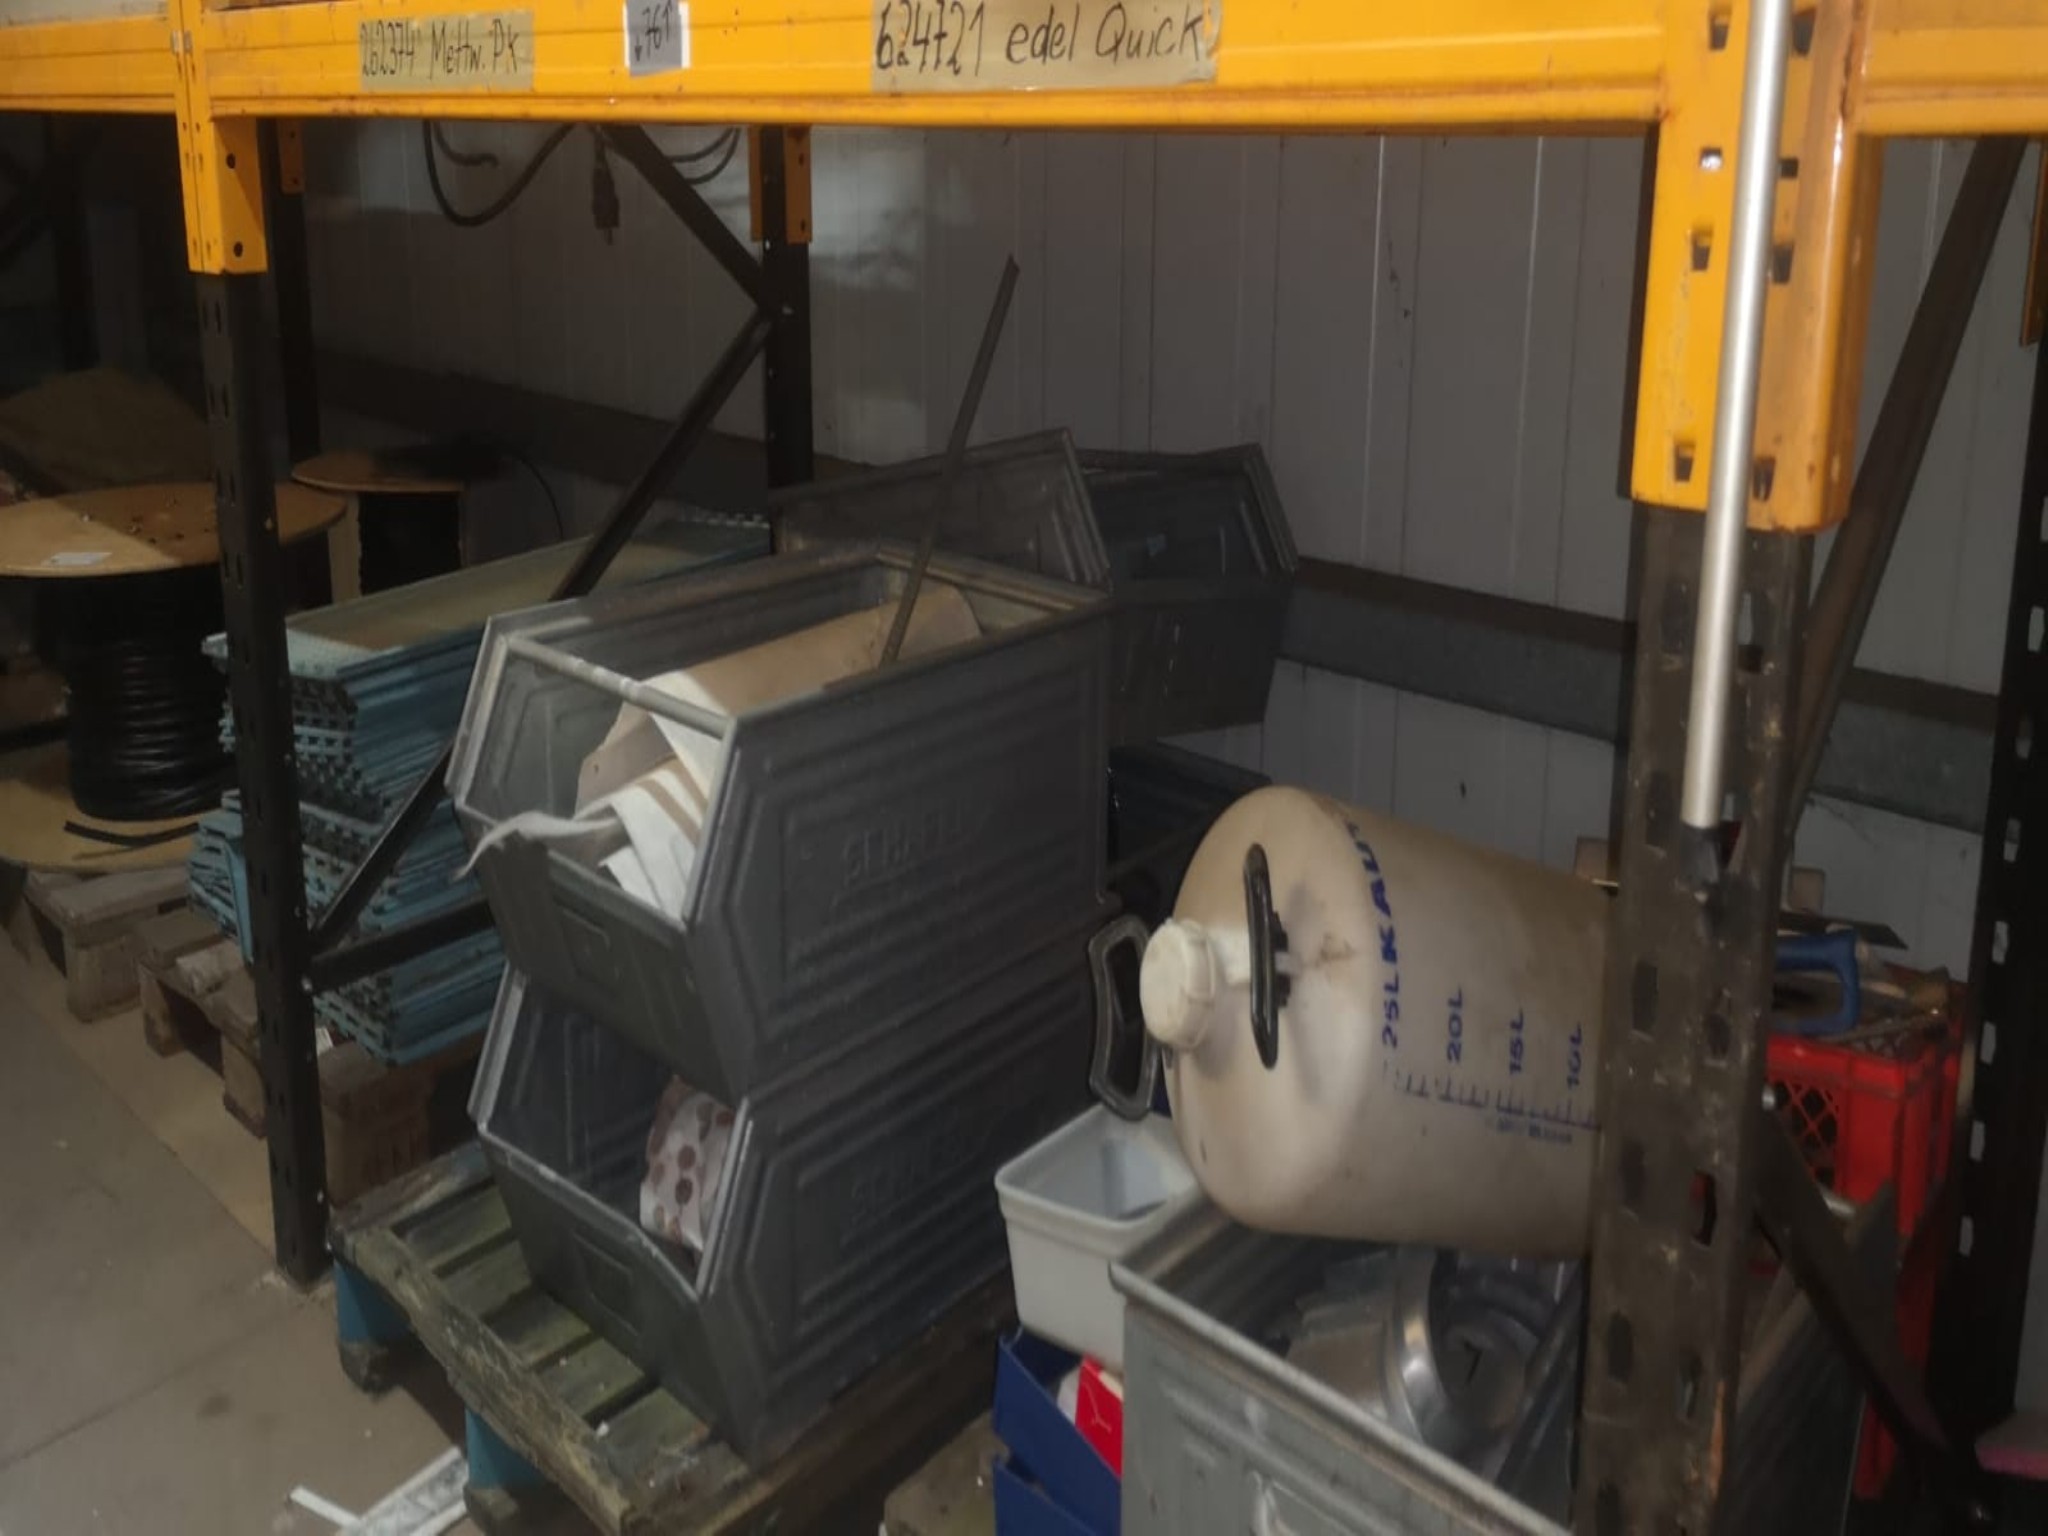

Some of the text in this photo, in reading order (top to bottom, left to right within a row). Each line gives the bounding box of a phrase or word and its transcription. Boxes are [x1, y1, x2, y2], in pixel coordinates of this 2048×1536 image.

[1004, 2, 1081, 65] edel
[1446, 984, 1464, 1064] 20L
[1508, 1007, 1525, 1076] 15L
[1566, 1020, 1583, 1089] 10L
